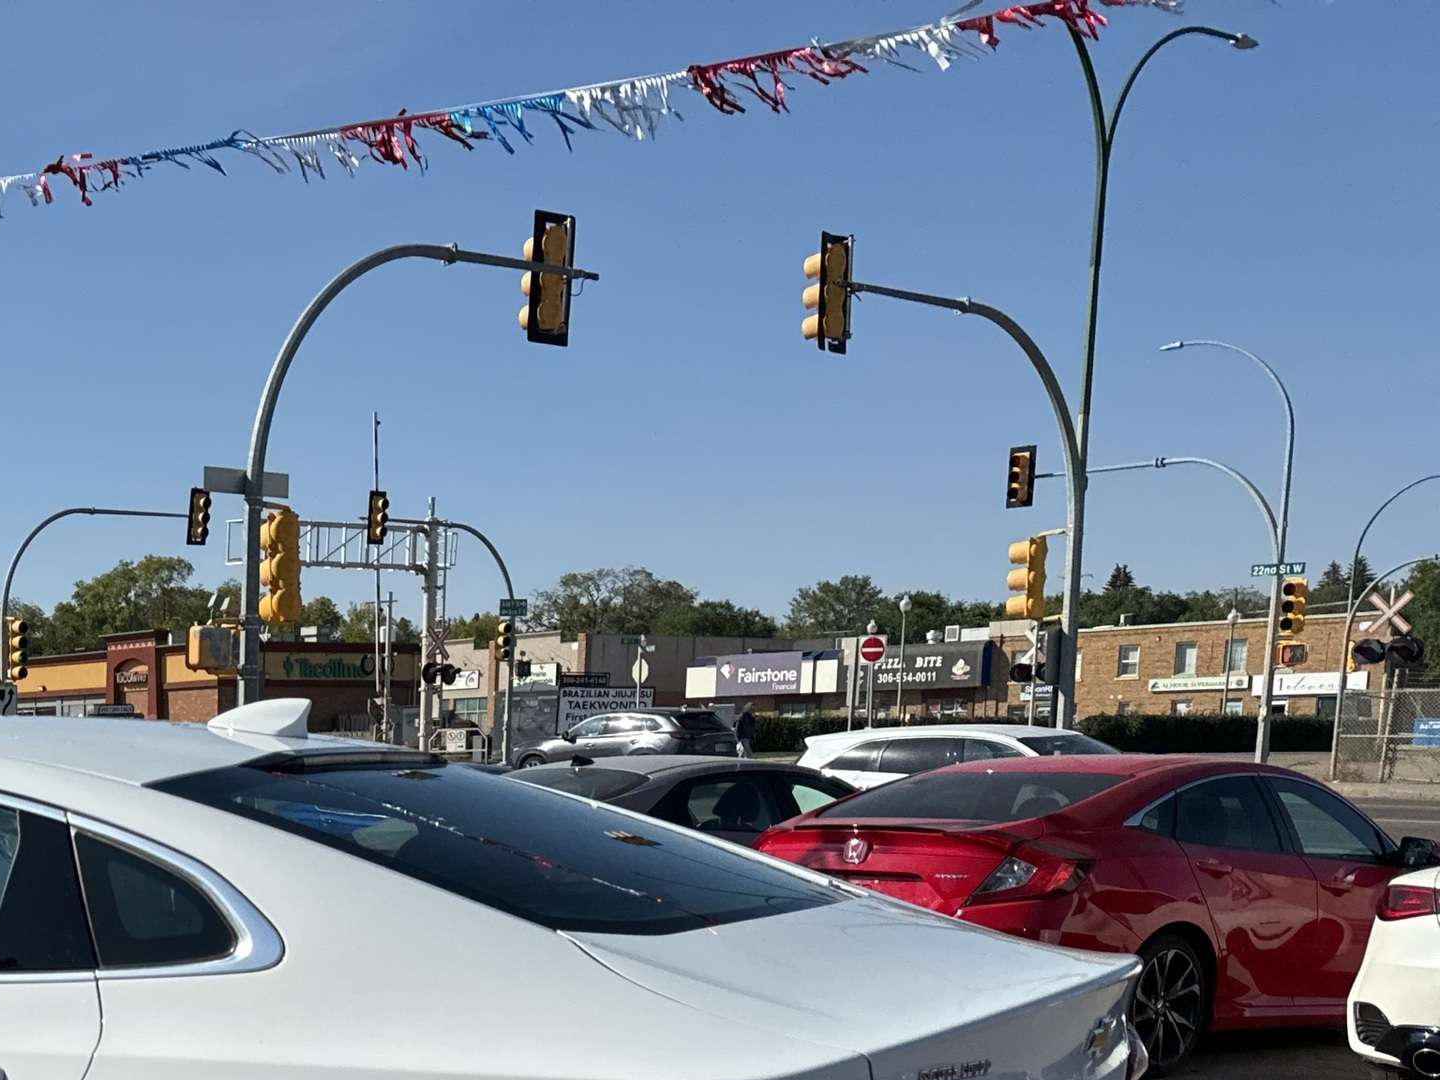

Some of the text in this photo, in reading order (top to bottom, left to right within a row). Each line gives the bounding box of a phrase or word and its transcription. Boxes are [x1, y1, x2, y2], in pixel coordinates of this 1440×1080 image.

[1252, 563, 1303, 576] 22nd St W
[915, 656, 943, 668] BITE
[738, 668, 797, 683] Fairstone
[772, 682, 797, 691] Financial
[562, 689, 610, 698] BRAZILIAN
